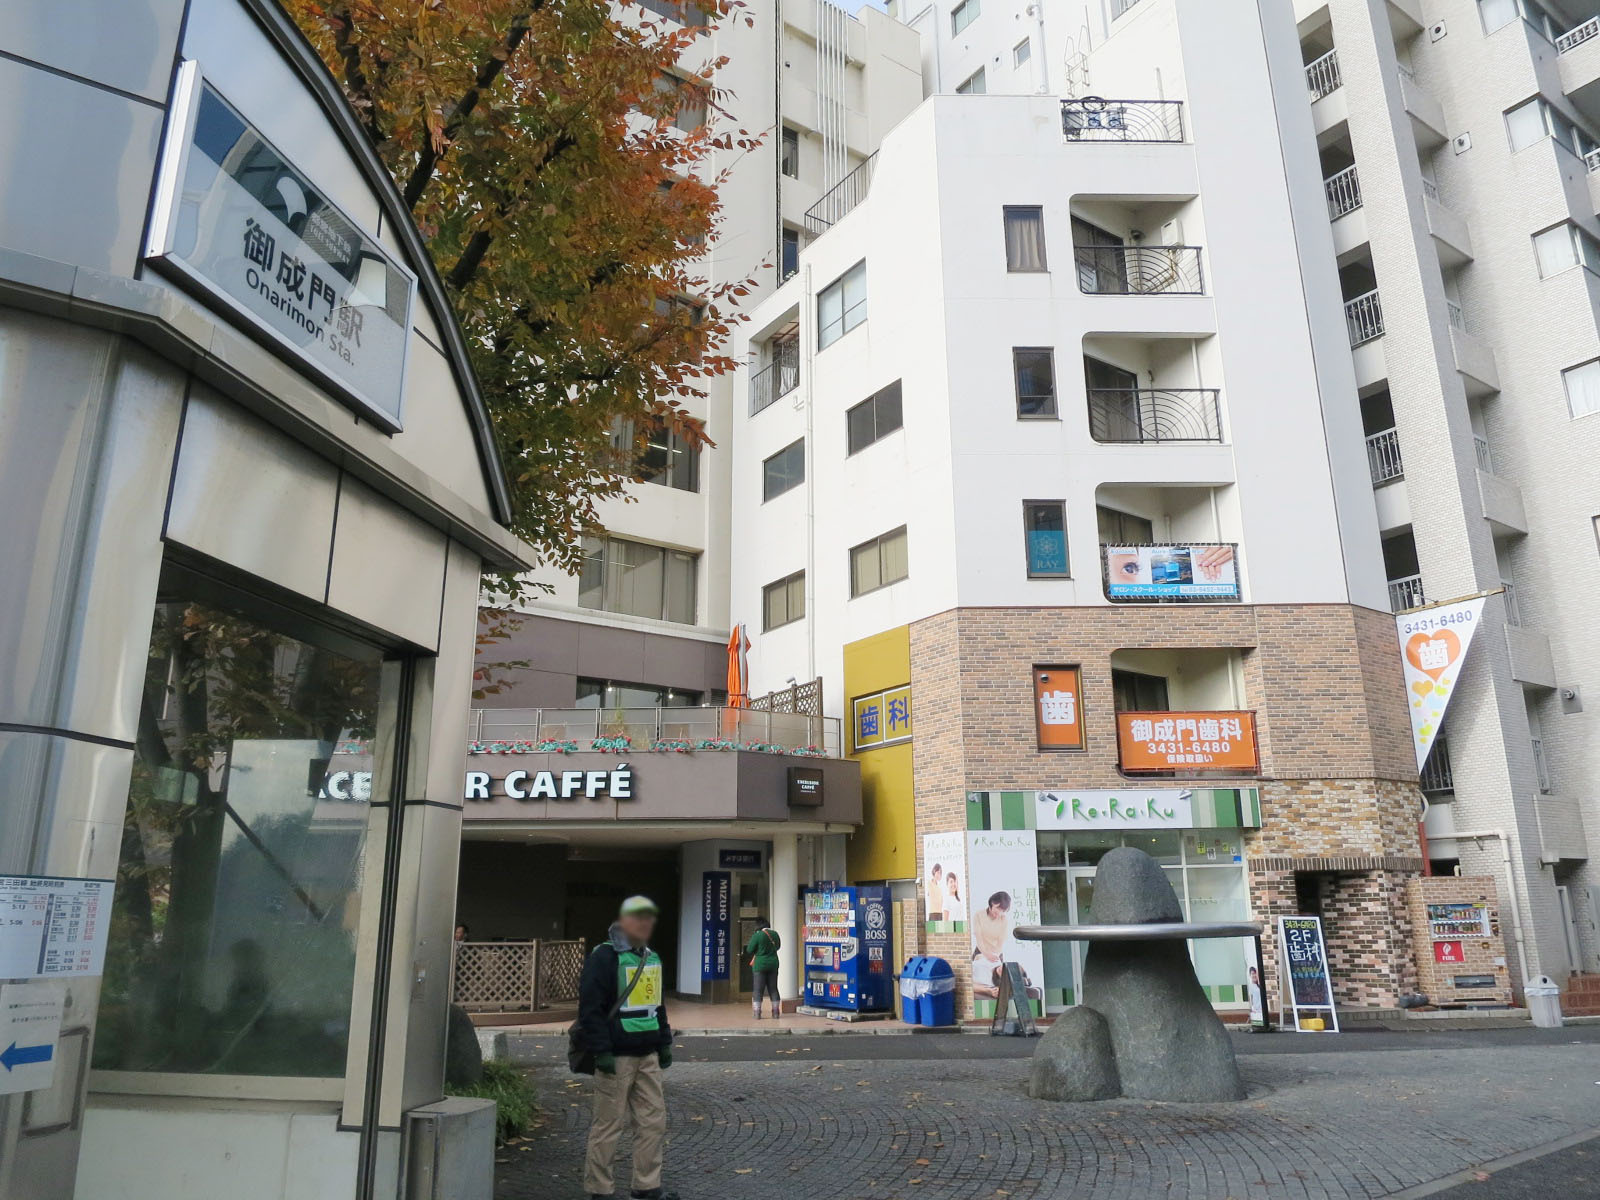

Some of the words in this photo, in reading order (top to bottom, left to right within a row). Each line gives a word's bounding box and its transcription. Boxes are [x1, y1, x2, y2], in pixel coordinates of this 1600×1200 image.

[243, 217, 363, 348] 御成門駅
[246, 268, 325, 343] Onarimon
[329, 333, 355, 366] Sta.
[1404, 610, 1473, 634] 3431-6480
[860, 696, 910, 738] 歯科
[1039, 690, 1075, 725] 歯
[1130, 718, 1242, 742] 御成門歯科
[1148, 742, 1230, 754] 3431-6480
[504, 762, 631, 799] CAFFÉ
[719, 880, 728, 921] MIZUHO
[866, 902, 884, 911] COFFEE
[865, 930, 887, 940] BOSS
[1289, 929, 1311, 942] 2F
[717, 929, 726, 973] みずほ銀行
[1289, 941, 1321, 961] 歯科
